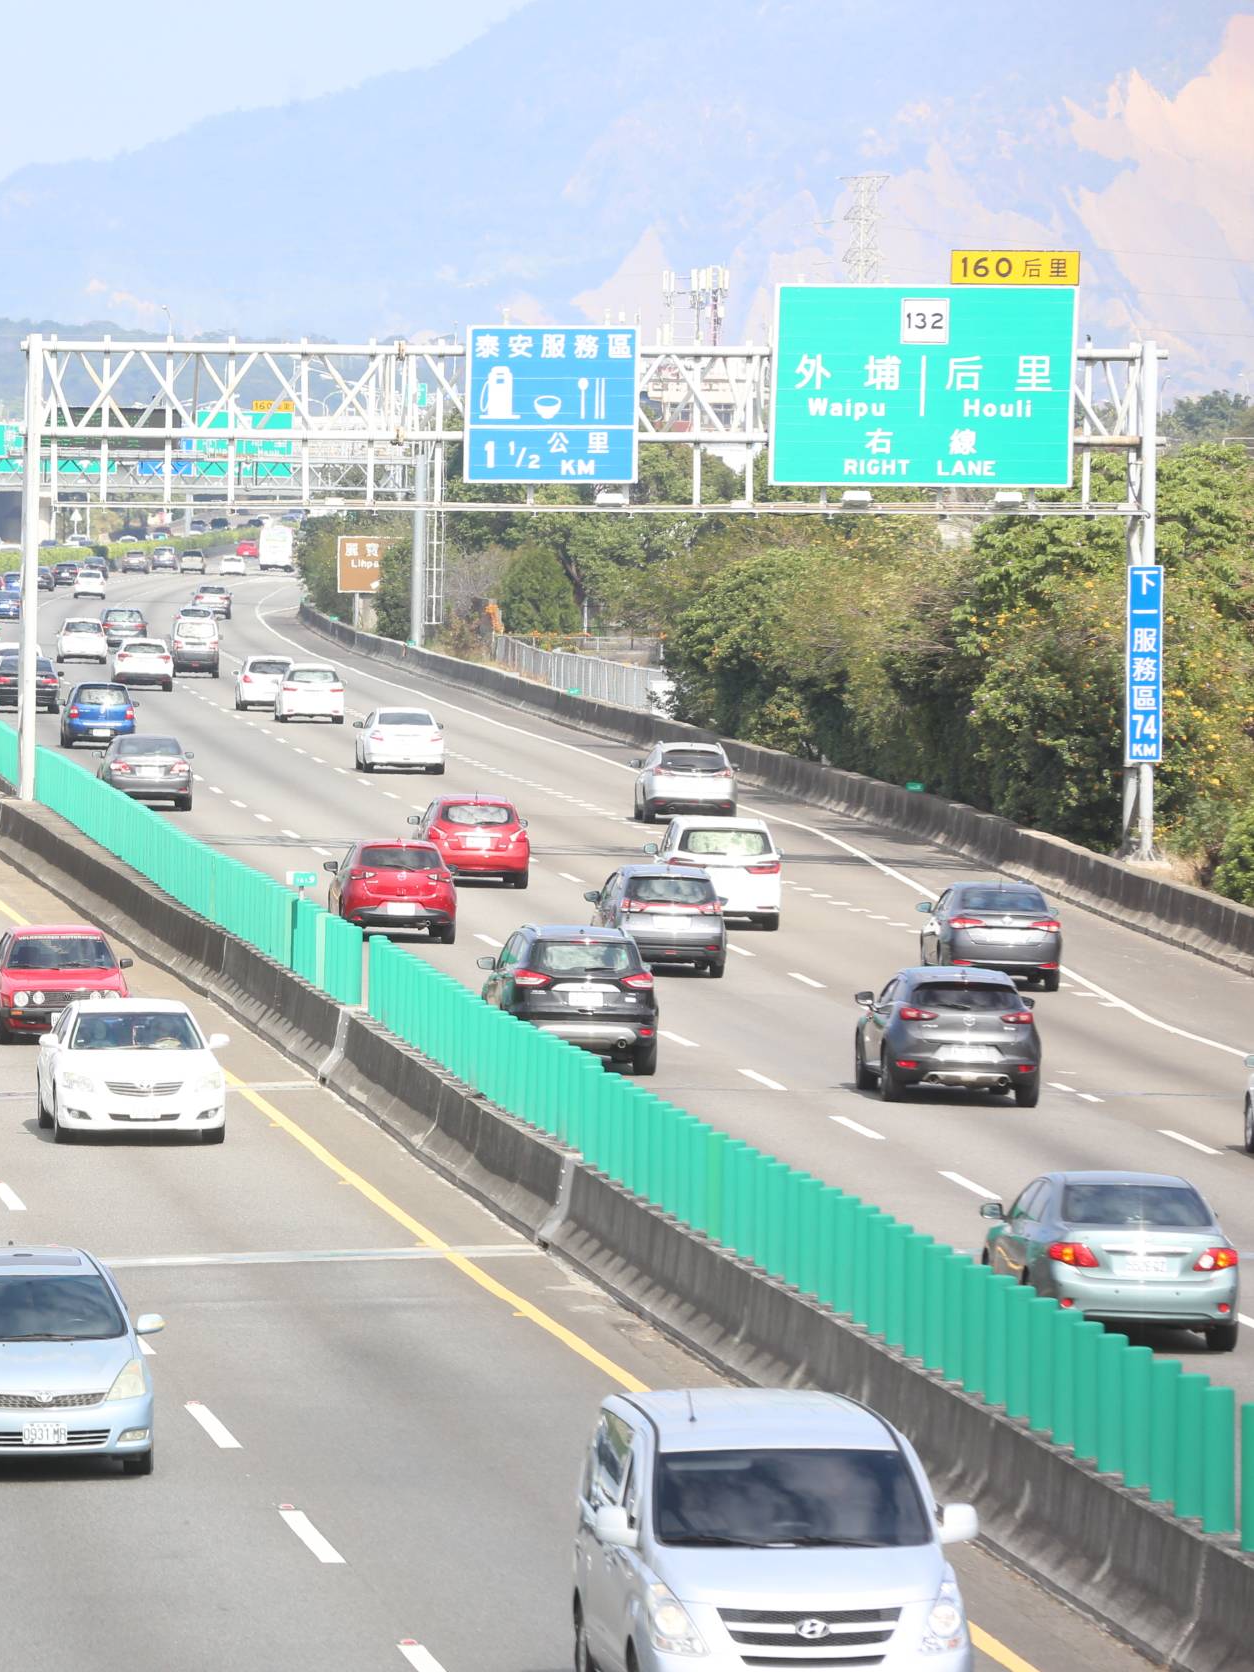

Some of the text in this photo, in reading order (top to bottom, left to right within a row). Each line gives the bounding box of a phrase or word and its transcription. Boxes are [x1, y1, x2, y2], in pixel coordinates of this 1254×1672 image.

[961, 257, 1068, 278] 160 后里
[906, 312, 944, 330] 132
[475, 333, 633, 359] 泰安服務區
[795, 354, 902, 391] 外埔
[945, 355, 1053, 392] 后里
[808, 398, 886, 421] Waipu
[963, 398, 1032, 418] Houli
[547, 431, 610, 454] 公里
[864, 428, 977, 455] 右線
[560, 459, 595, 476] KM
[844, 459, 996, 477] RIGHT LANE
[1132, 570, 1159, 757] 下一服務區 74 KM
